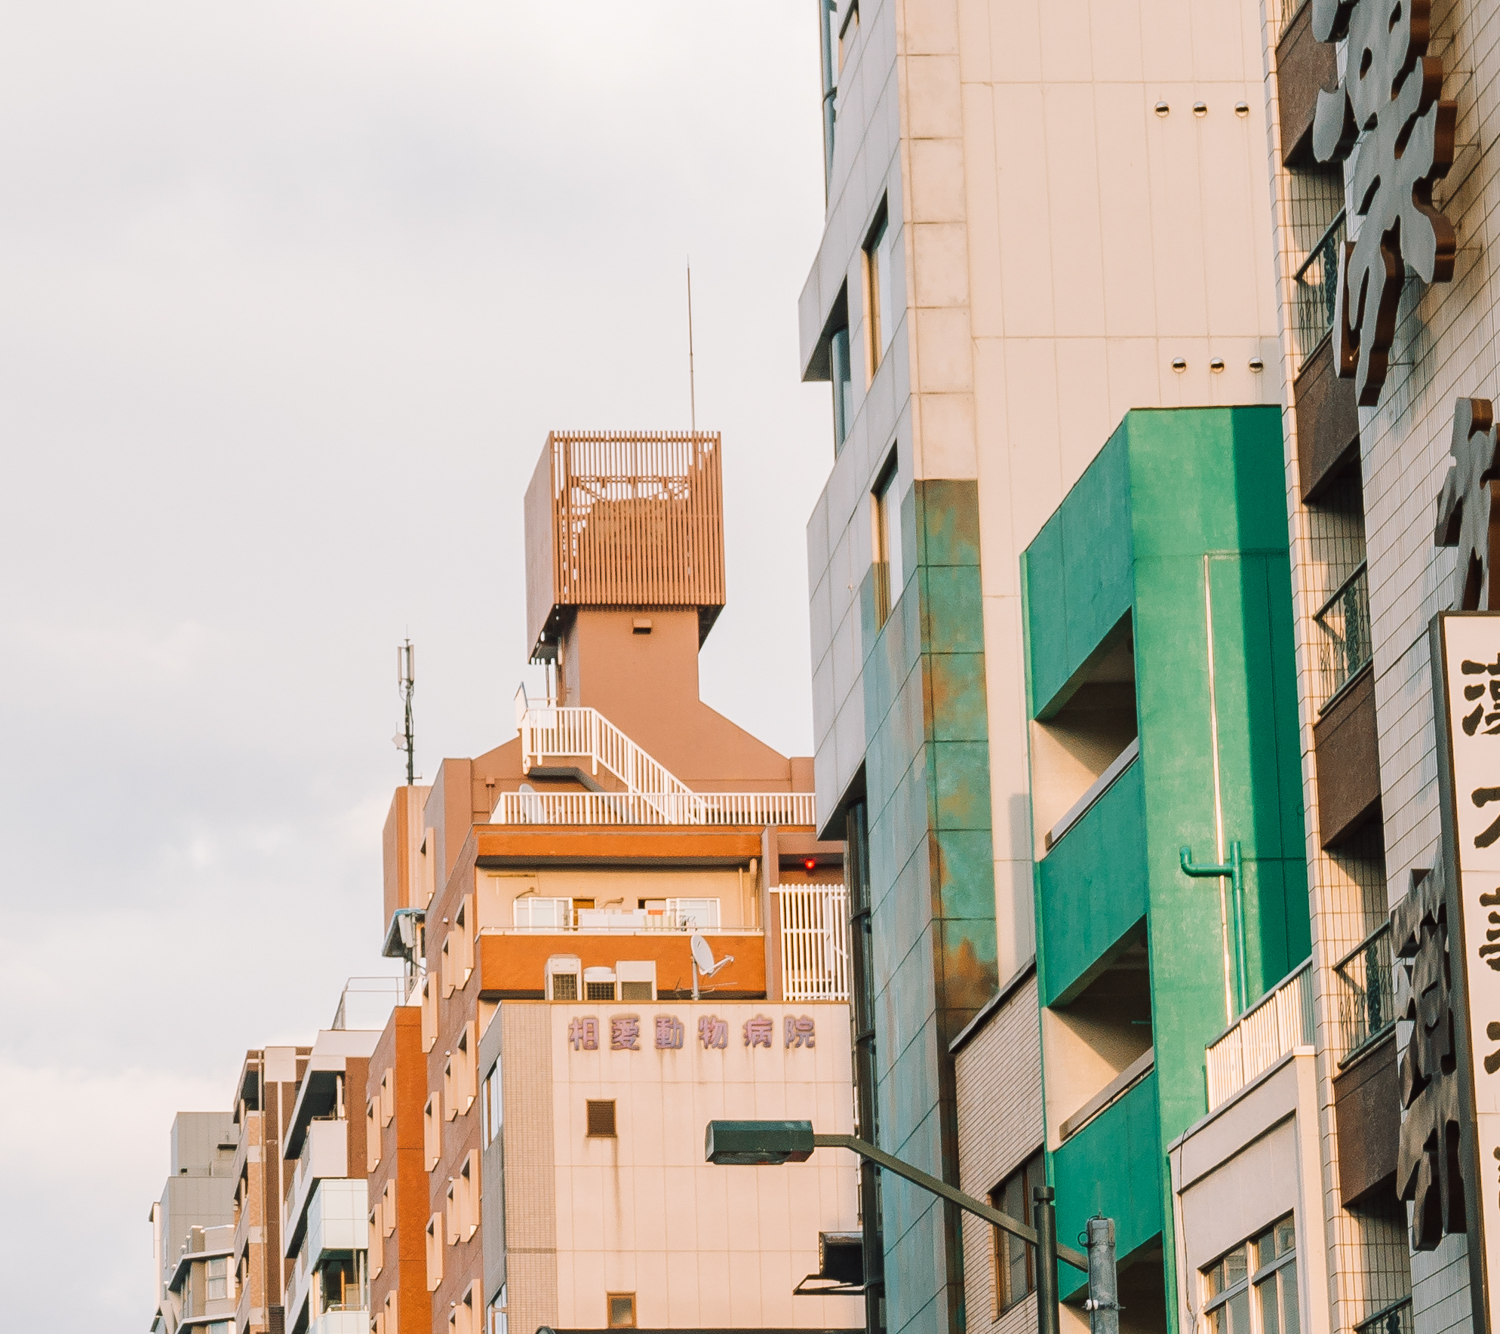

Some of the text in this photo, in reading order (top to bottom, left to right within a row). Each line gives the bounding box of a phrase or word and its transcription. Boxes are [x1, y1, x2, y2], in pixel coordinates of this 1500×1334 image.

[568, 1012, 816, 1053] 相愛動物病院
